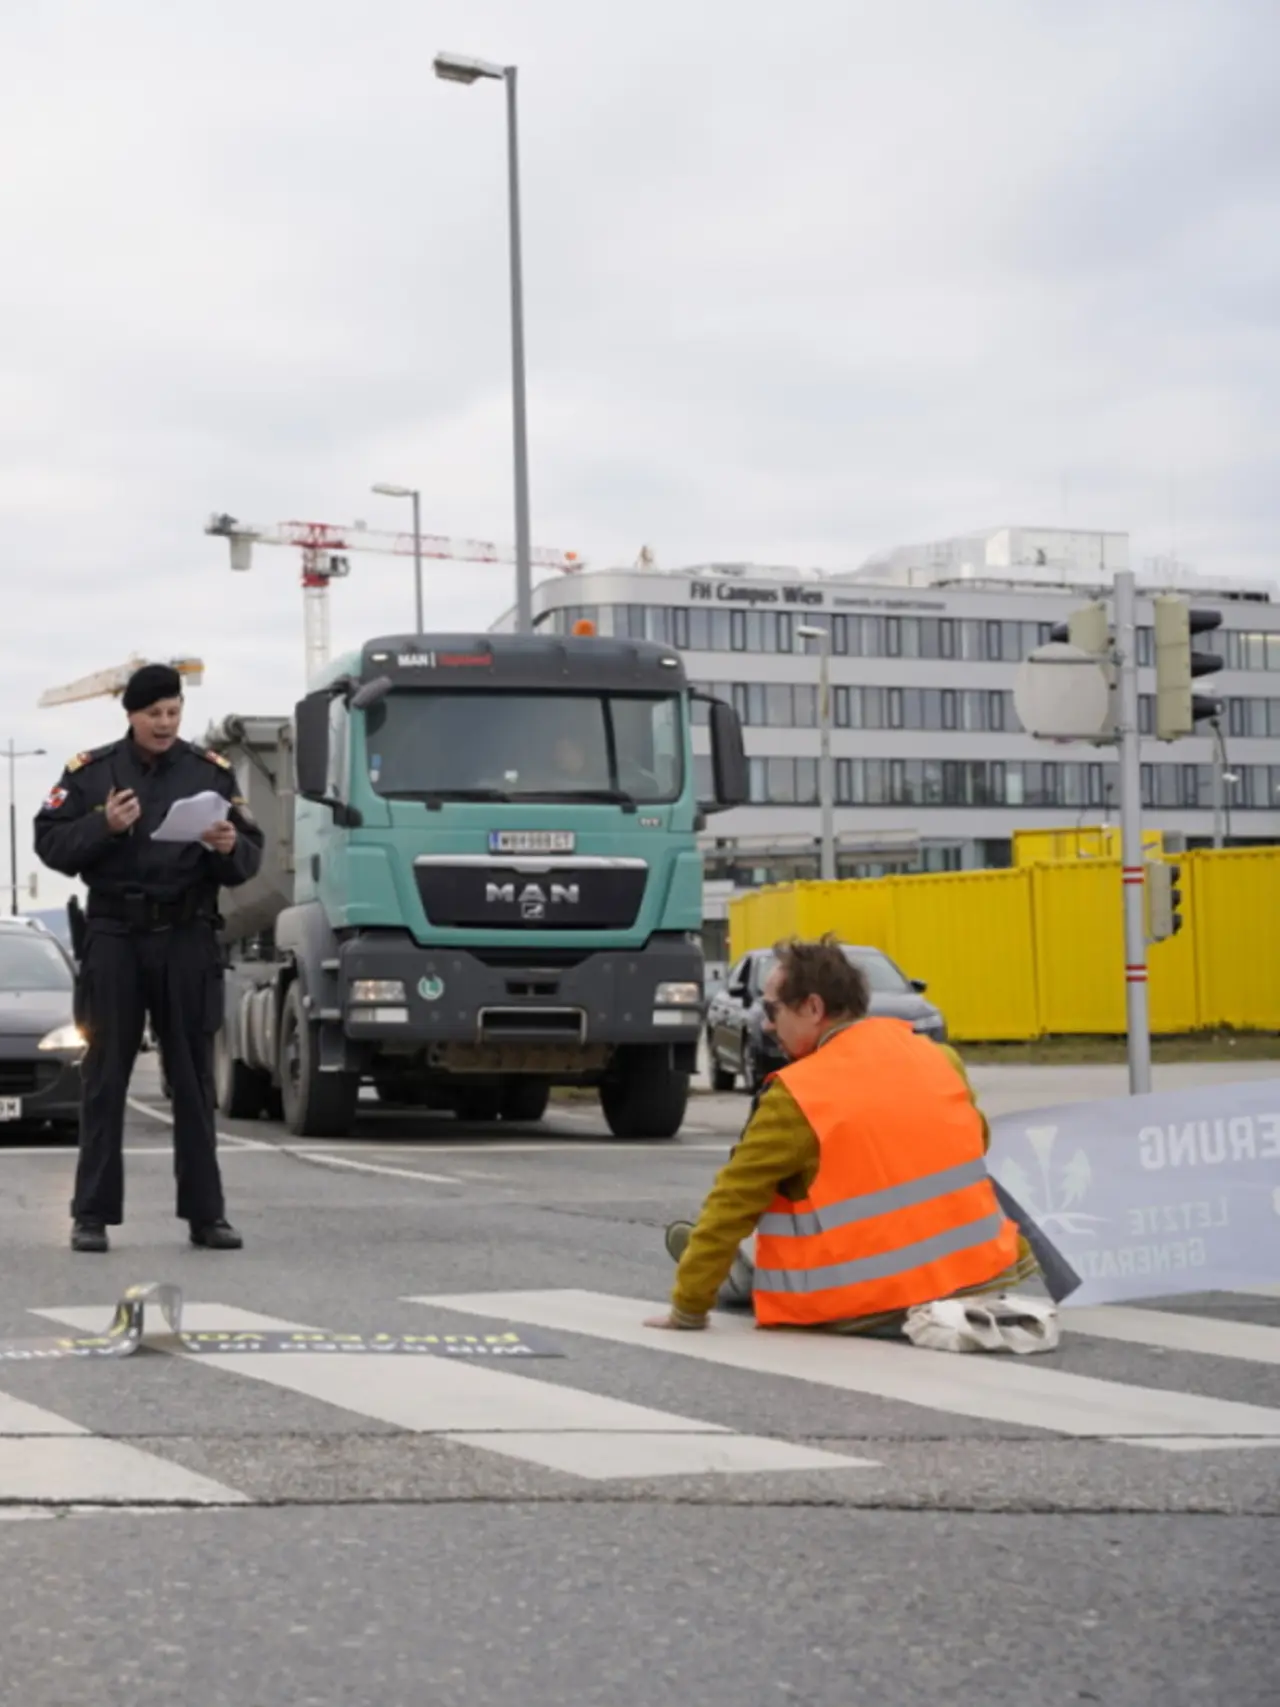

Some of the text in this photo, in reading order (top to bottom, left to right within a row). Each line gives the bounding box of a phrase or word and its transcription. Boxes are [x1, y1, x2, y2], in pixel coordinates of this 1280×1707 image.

[690, 581, 823, 607] FH Campus Wien
[397, 653, 428, 667] MAN
[485, 882, 579, 903] MAN
